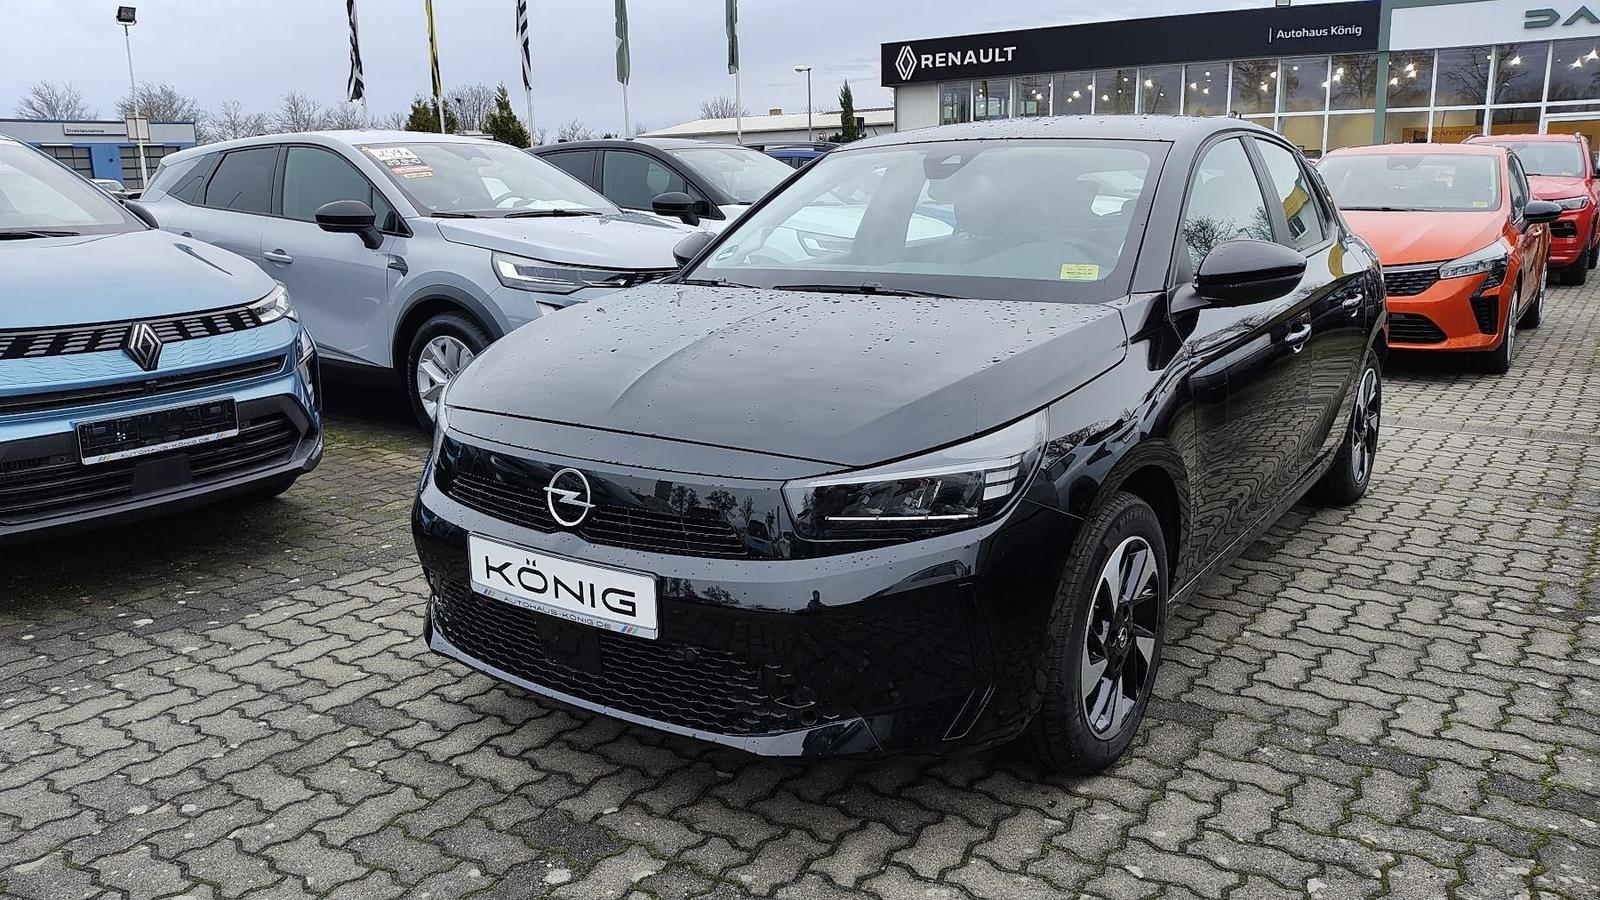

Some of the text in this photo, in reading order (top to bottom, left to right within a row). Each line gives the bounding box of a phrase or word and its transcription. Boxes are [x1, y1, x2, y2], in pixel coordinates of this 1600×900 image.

[1276, 25, 1363, 39] Autohaus König
[920, 46, 1017, 69] RENAULT
[485, 555, 637, 617] KÖNIG
